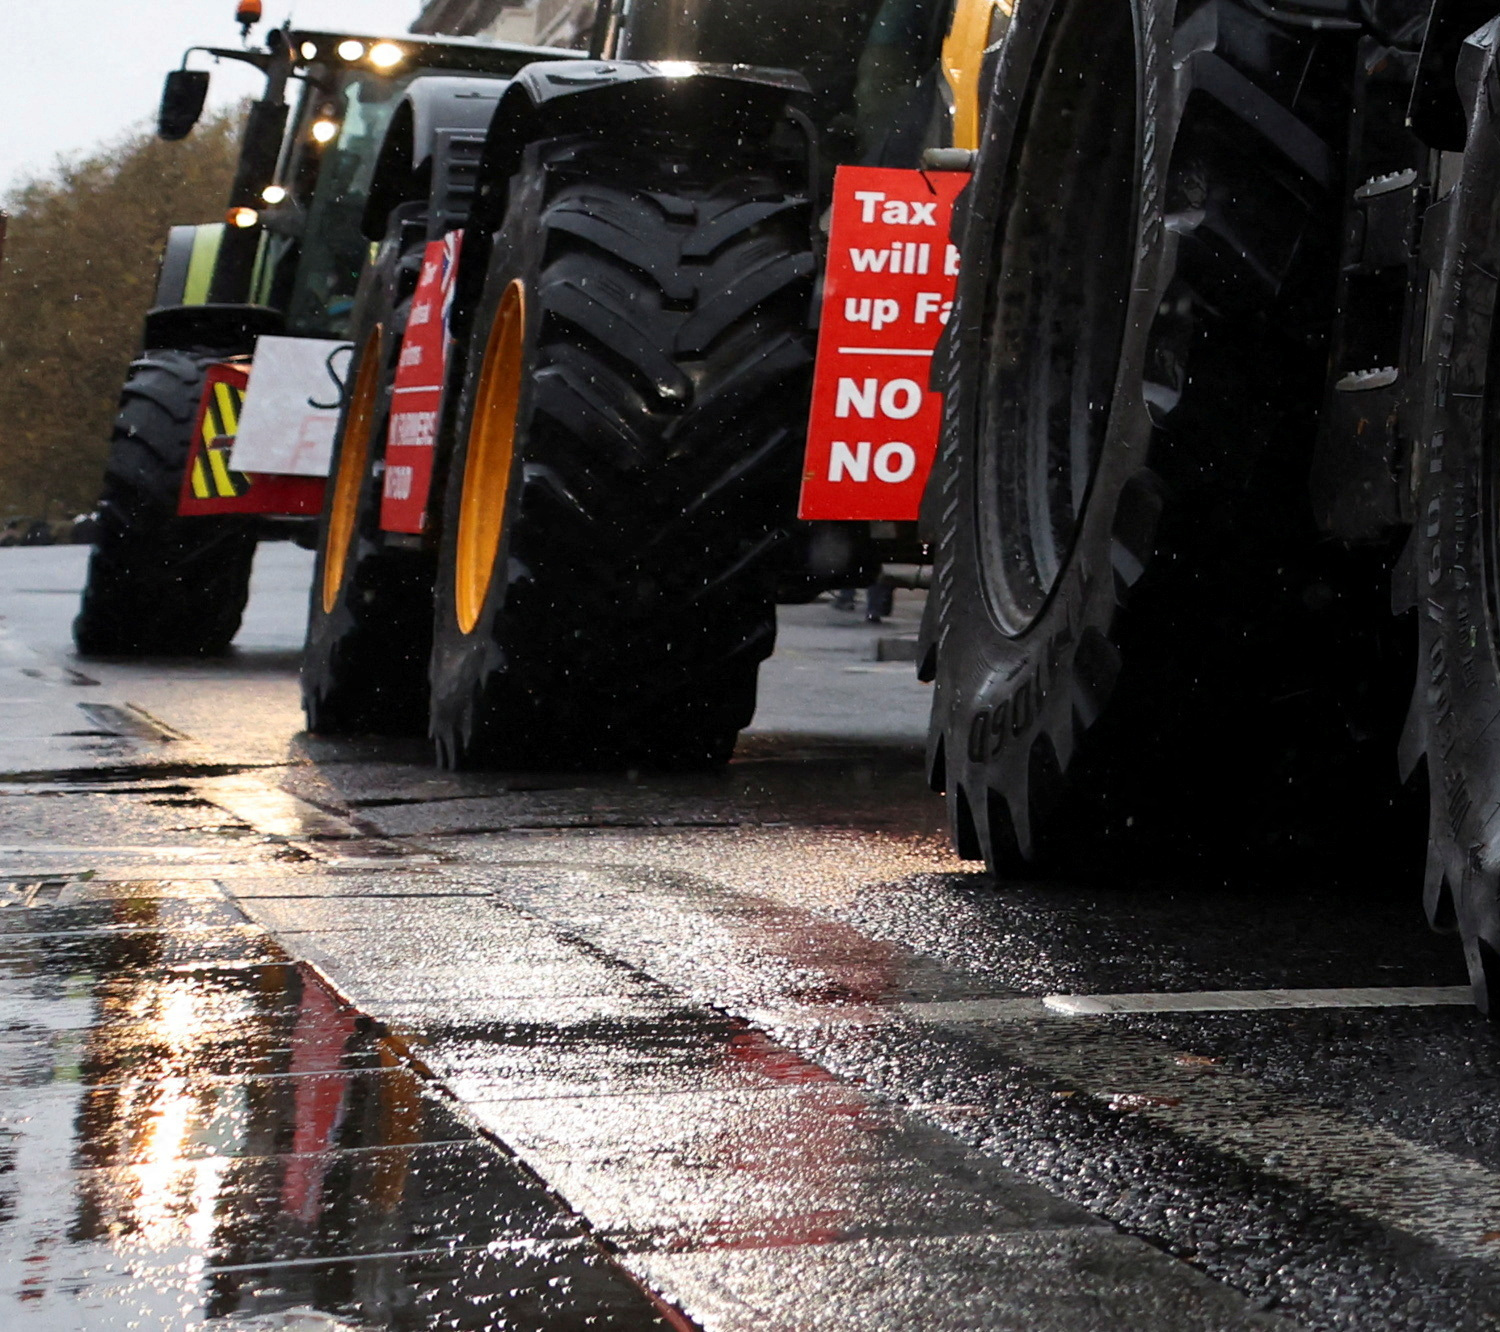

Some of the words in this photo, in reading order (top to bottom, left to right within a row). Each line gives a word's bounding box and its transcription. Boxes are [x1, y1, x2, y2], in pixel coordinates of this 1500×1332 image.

[854, 191, 937, 226] Tax
[849, 241, 930, 275] will
[844, 296, 900, 331] up
[835, 377, 922, 420] NO
[828, 441, 916, 483] NO
